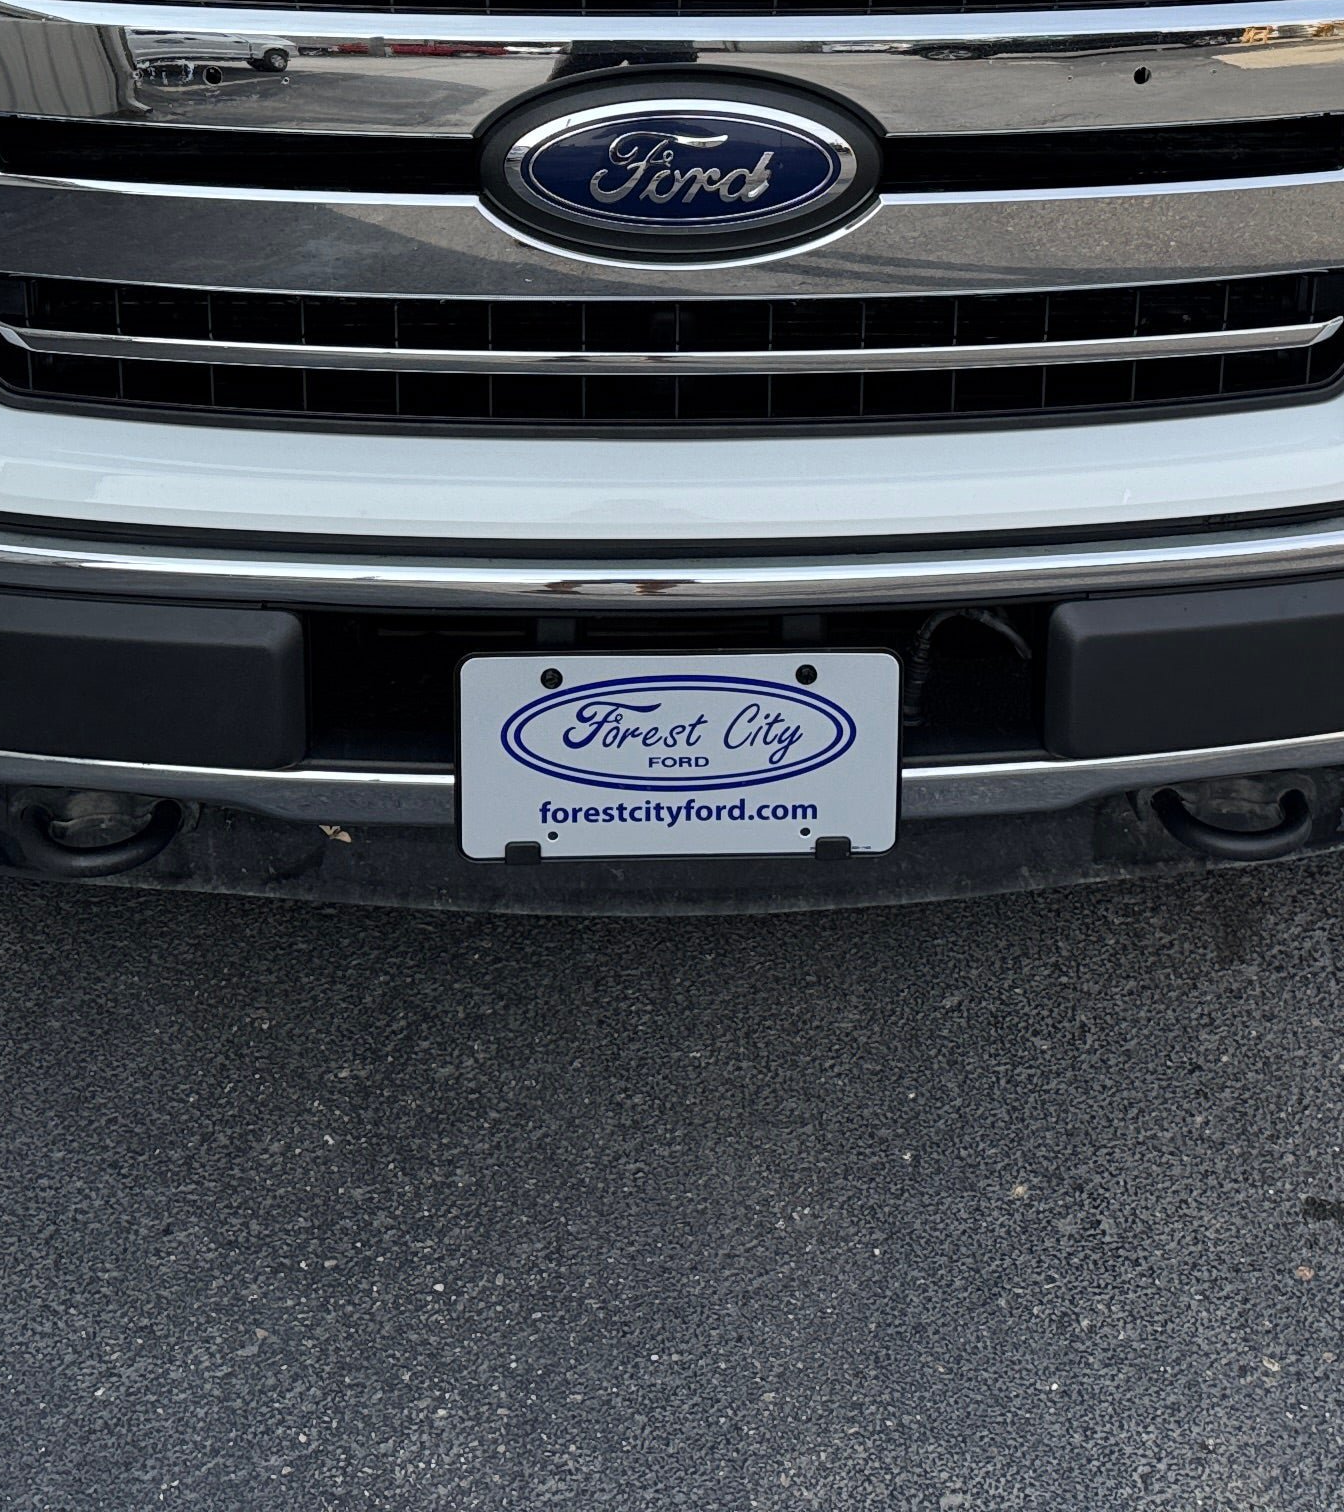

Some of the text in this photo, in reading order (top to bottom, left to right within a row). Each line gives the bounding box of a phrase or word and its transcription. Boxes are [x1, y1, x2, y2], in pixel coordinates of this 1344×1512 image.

[589, 130, 775, 204] Ford
[562, 700, 804, 765] Forest City
[648, 756, 710, 768] FORD
[539, 798, 818, 828] forestcityford.com
